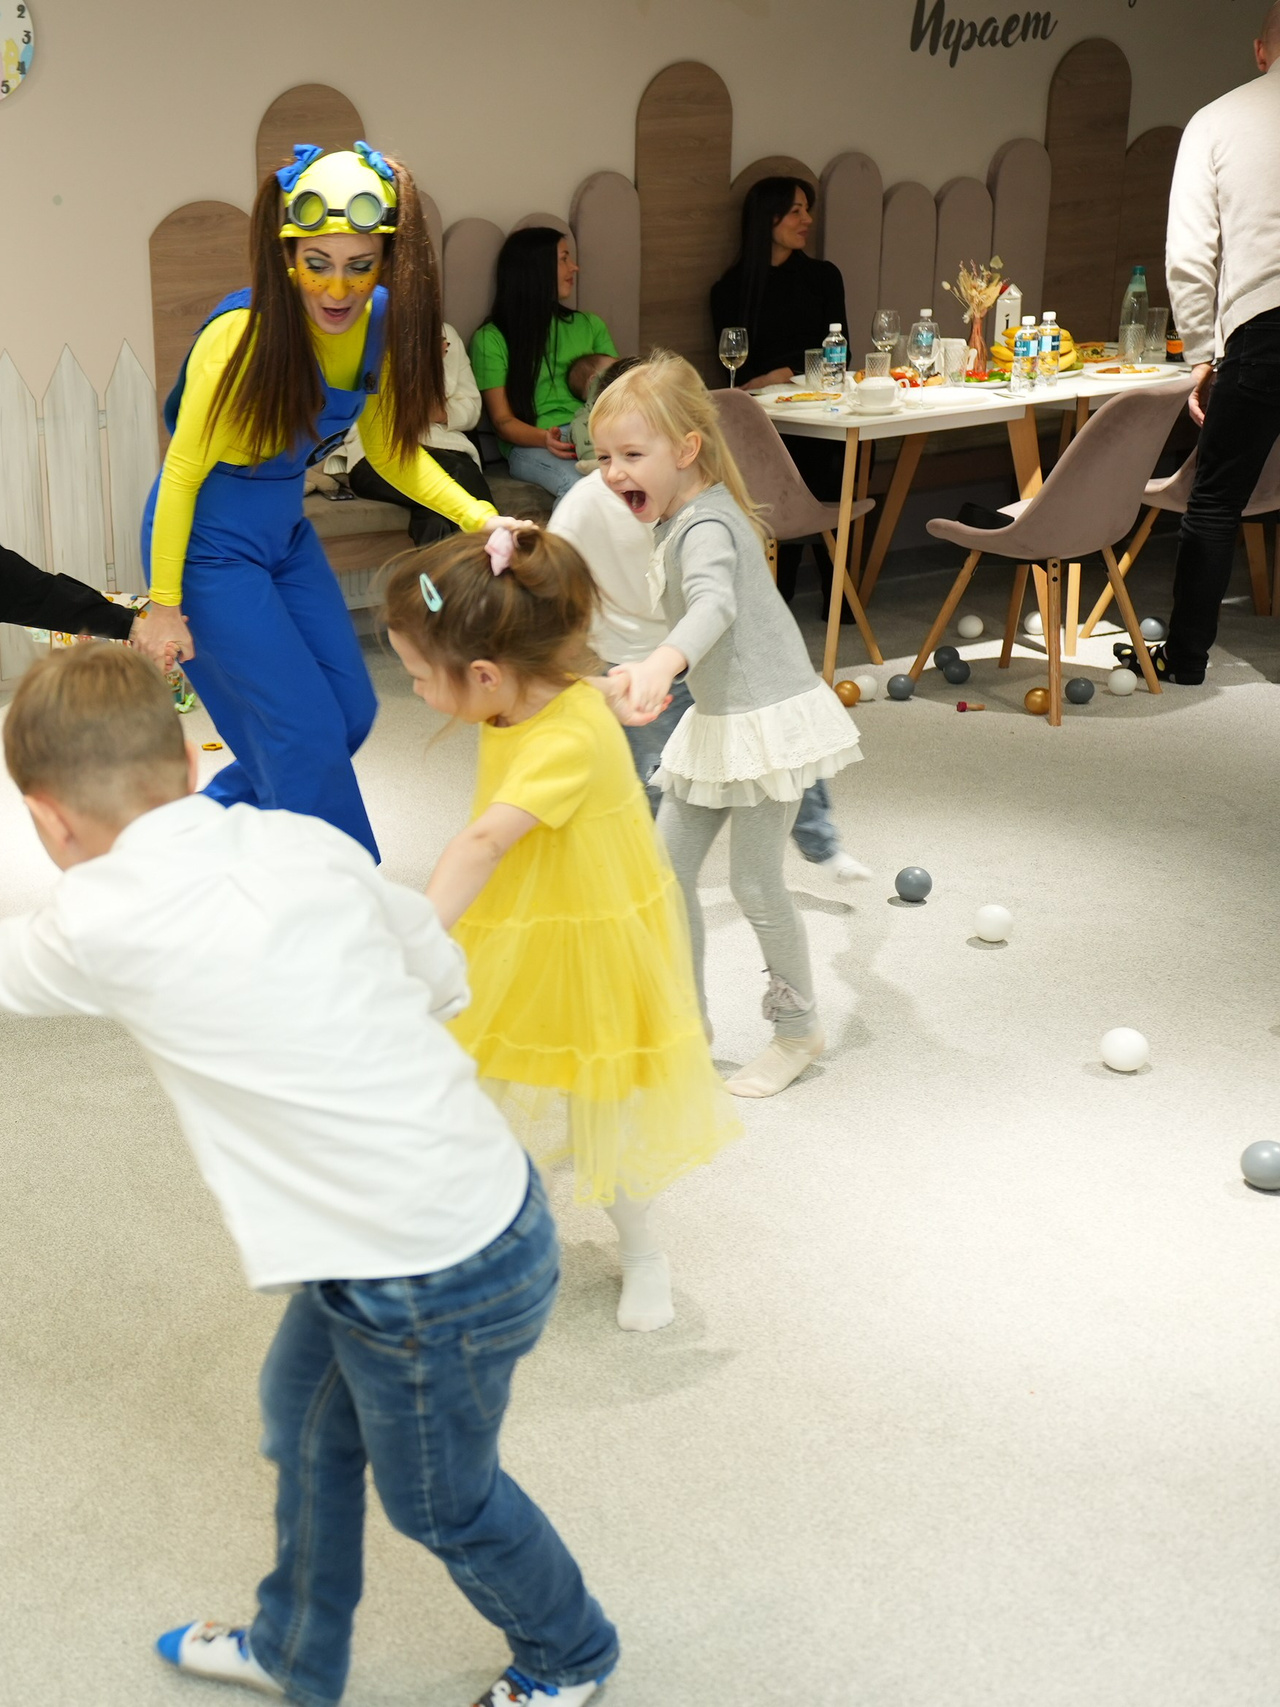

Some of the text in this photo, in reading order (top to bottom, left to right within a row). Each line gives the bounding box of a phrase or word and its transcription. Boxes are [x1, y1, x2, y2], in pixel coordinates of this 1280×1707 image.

[16, 4, 26, 18] 2
[22, 30, 31, 45] 3
[16, 61, 26, 75] 4
[0, 80, 10, 94] 5
